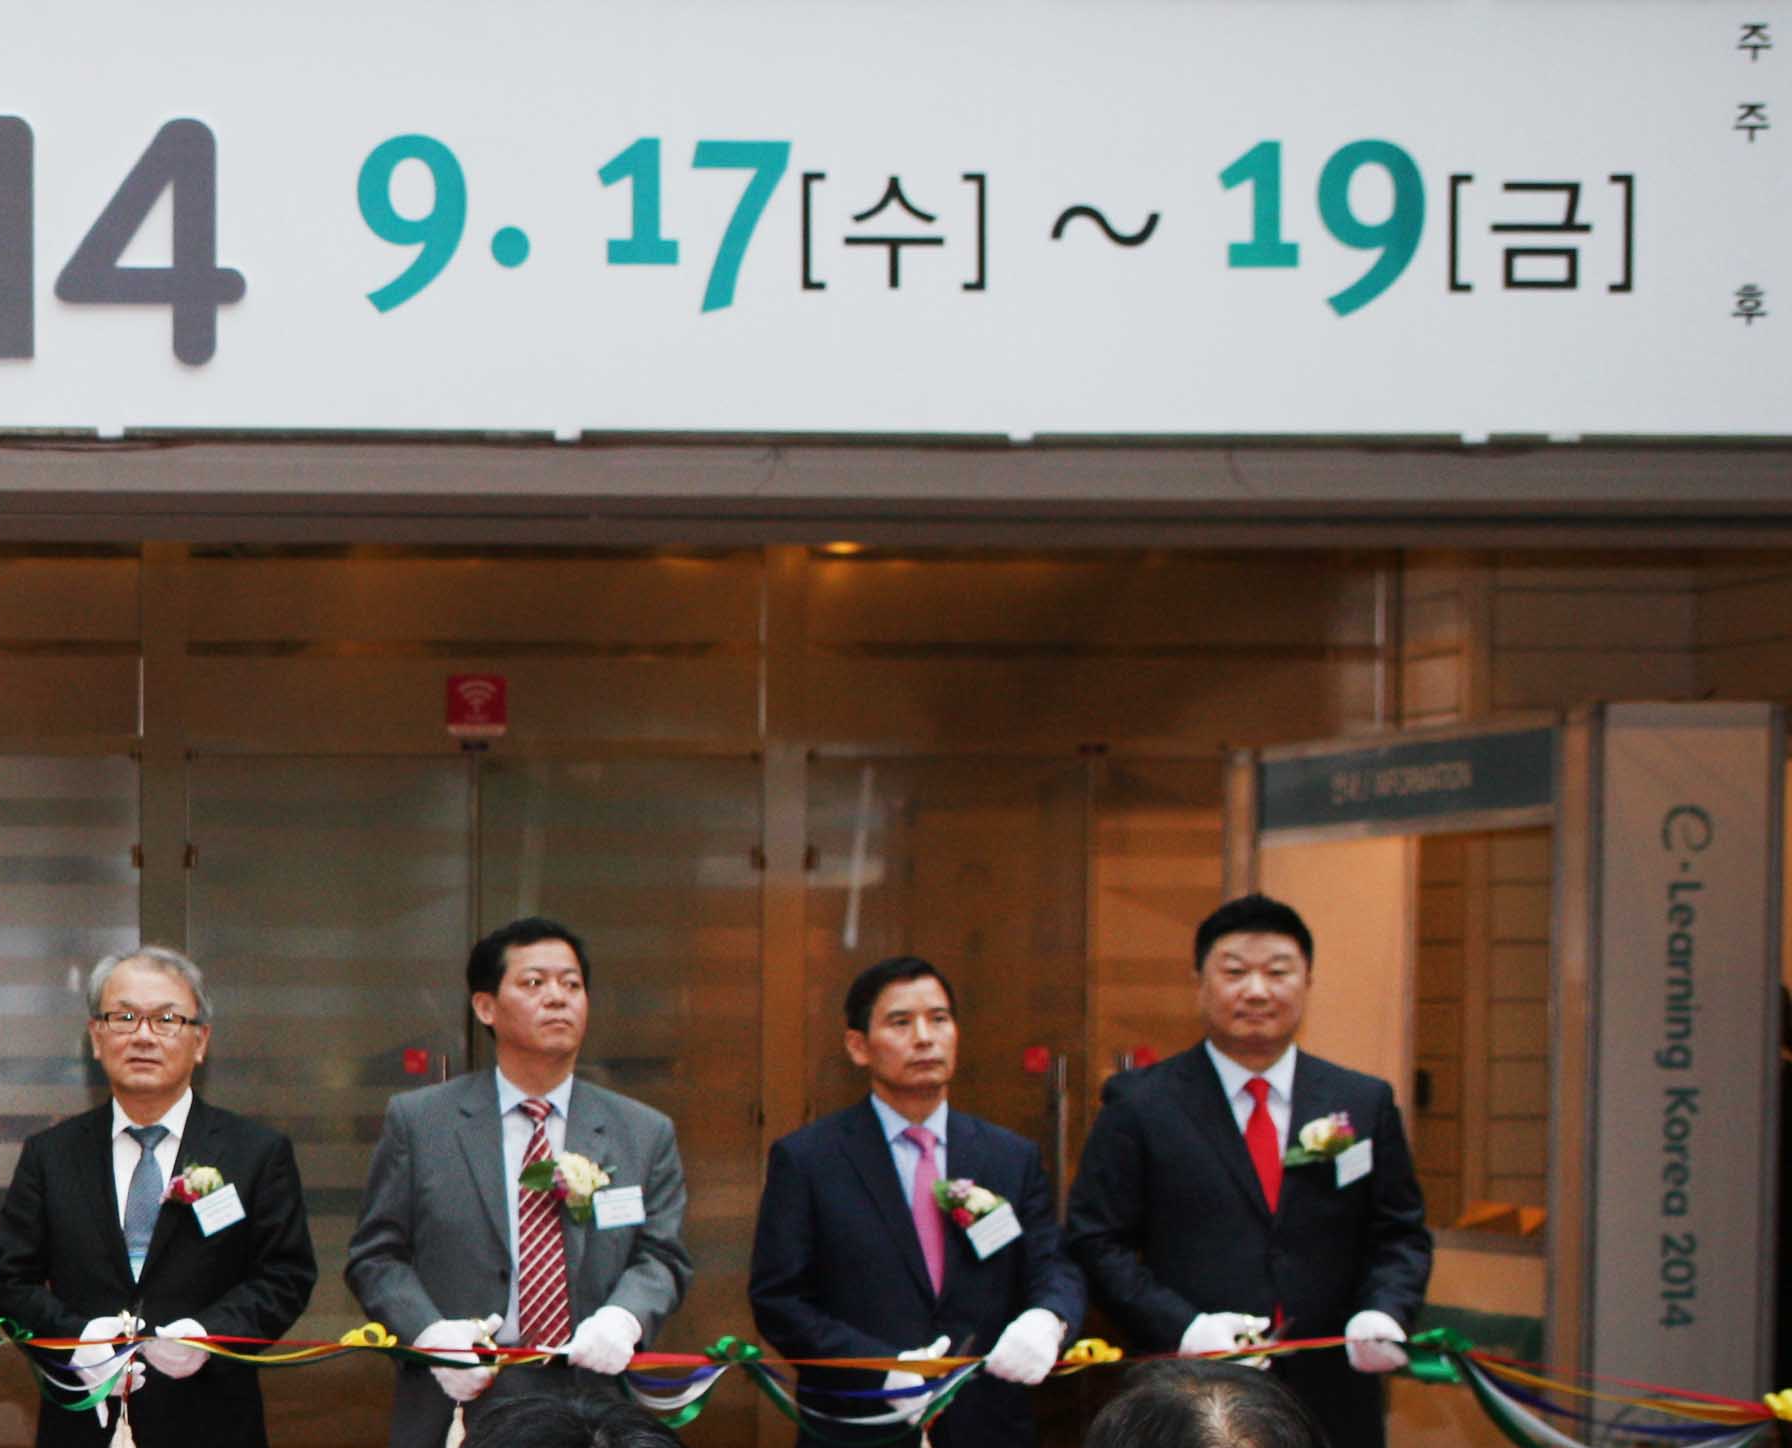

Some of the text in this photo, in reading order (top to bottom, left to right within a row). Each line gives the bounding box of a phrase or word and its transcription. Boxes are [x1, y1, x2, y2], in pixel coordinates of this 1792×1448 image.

[1737, 23, 1772, 62] 주
[1734, 103, 1770, 143] 주
[356, 133, 533, 316] 9.
[1731, 284, 1768, 326] 후
[1655, 803, 1714, 1329] e-Learning Korea 2014
